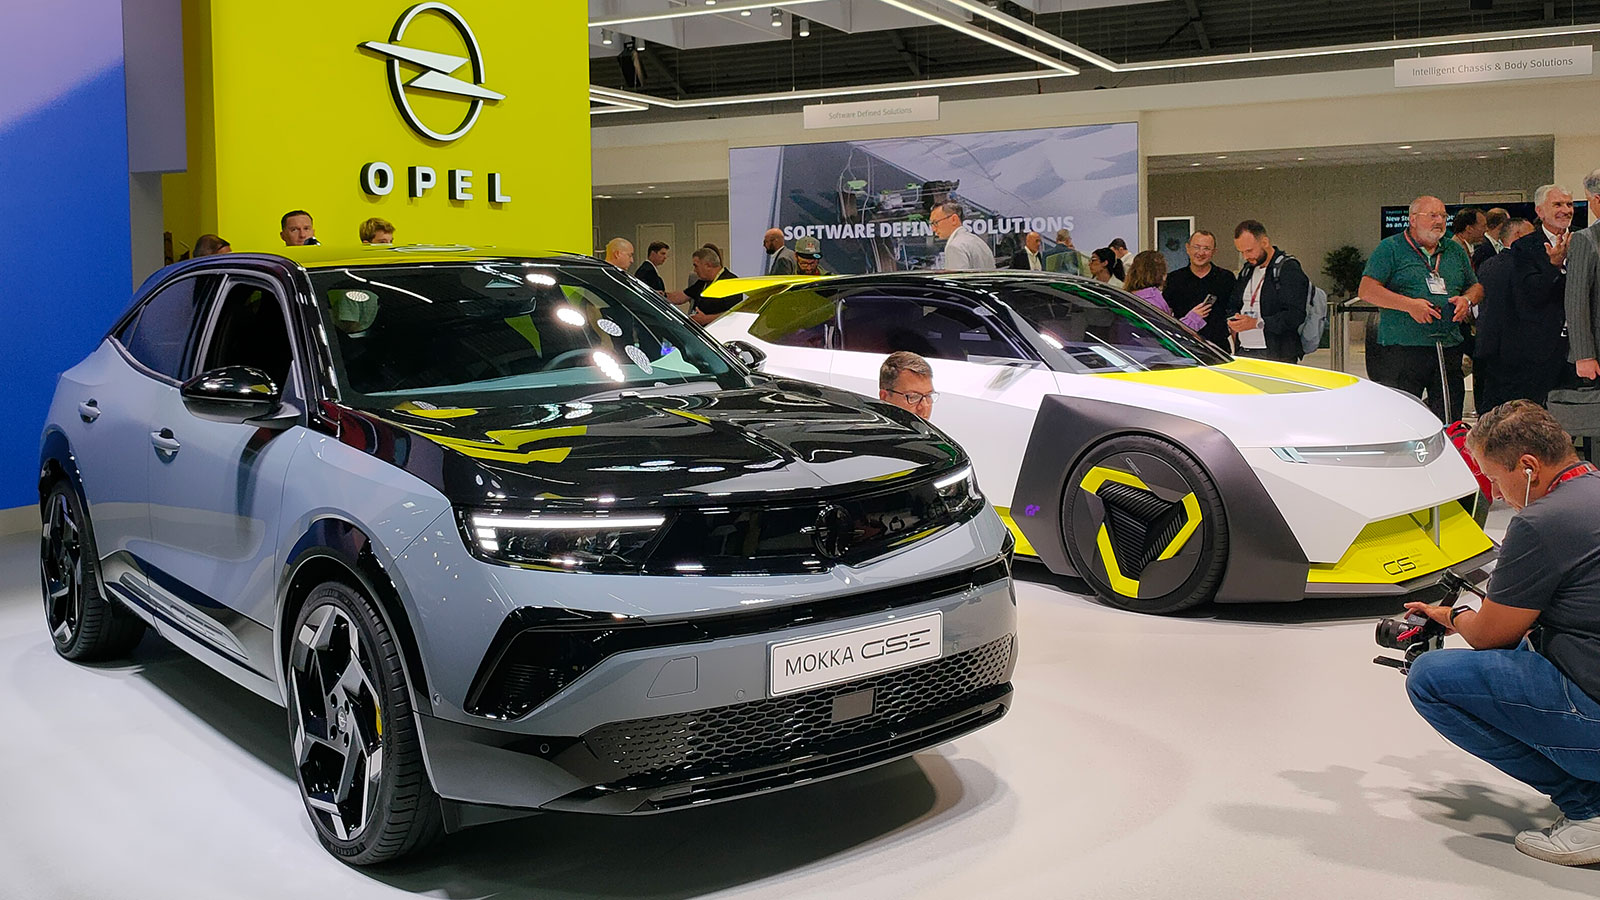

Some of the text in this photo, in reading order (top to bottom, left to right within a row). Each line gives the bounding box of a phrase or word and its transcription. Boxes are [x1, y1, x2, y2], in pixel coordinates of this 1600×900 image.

[1412, 57, 1574, 77] Intelligent Chassis & Body Solutions
[828, 107, 912, 120] Software Defined Solutions
[360, 162, 511, 203] OPEL
[783, 215, 1075, 241] SOFTWARE DEFIN SOLUTIONS
[785, 628, 931, 677] MOKKA GSE
